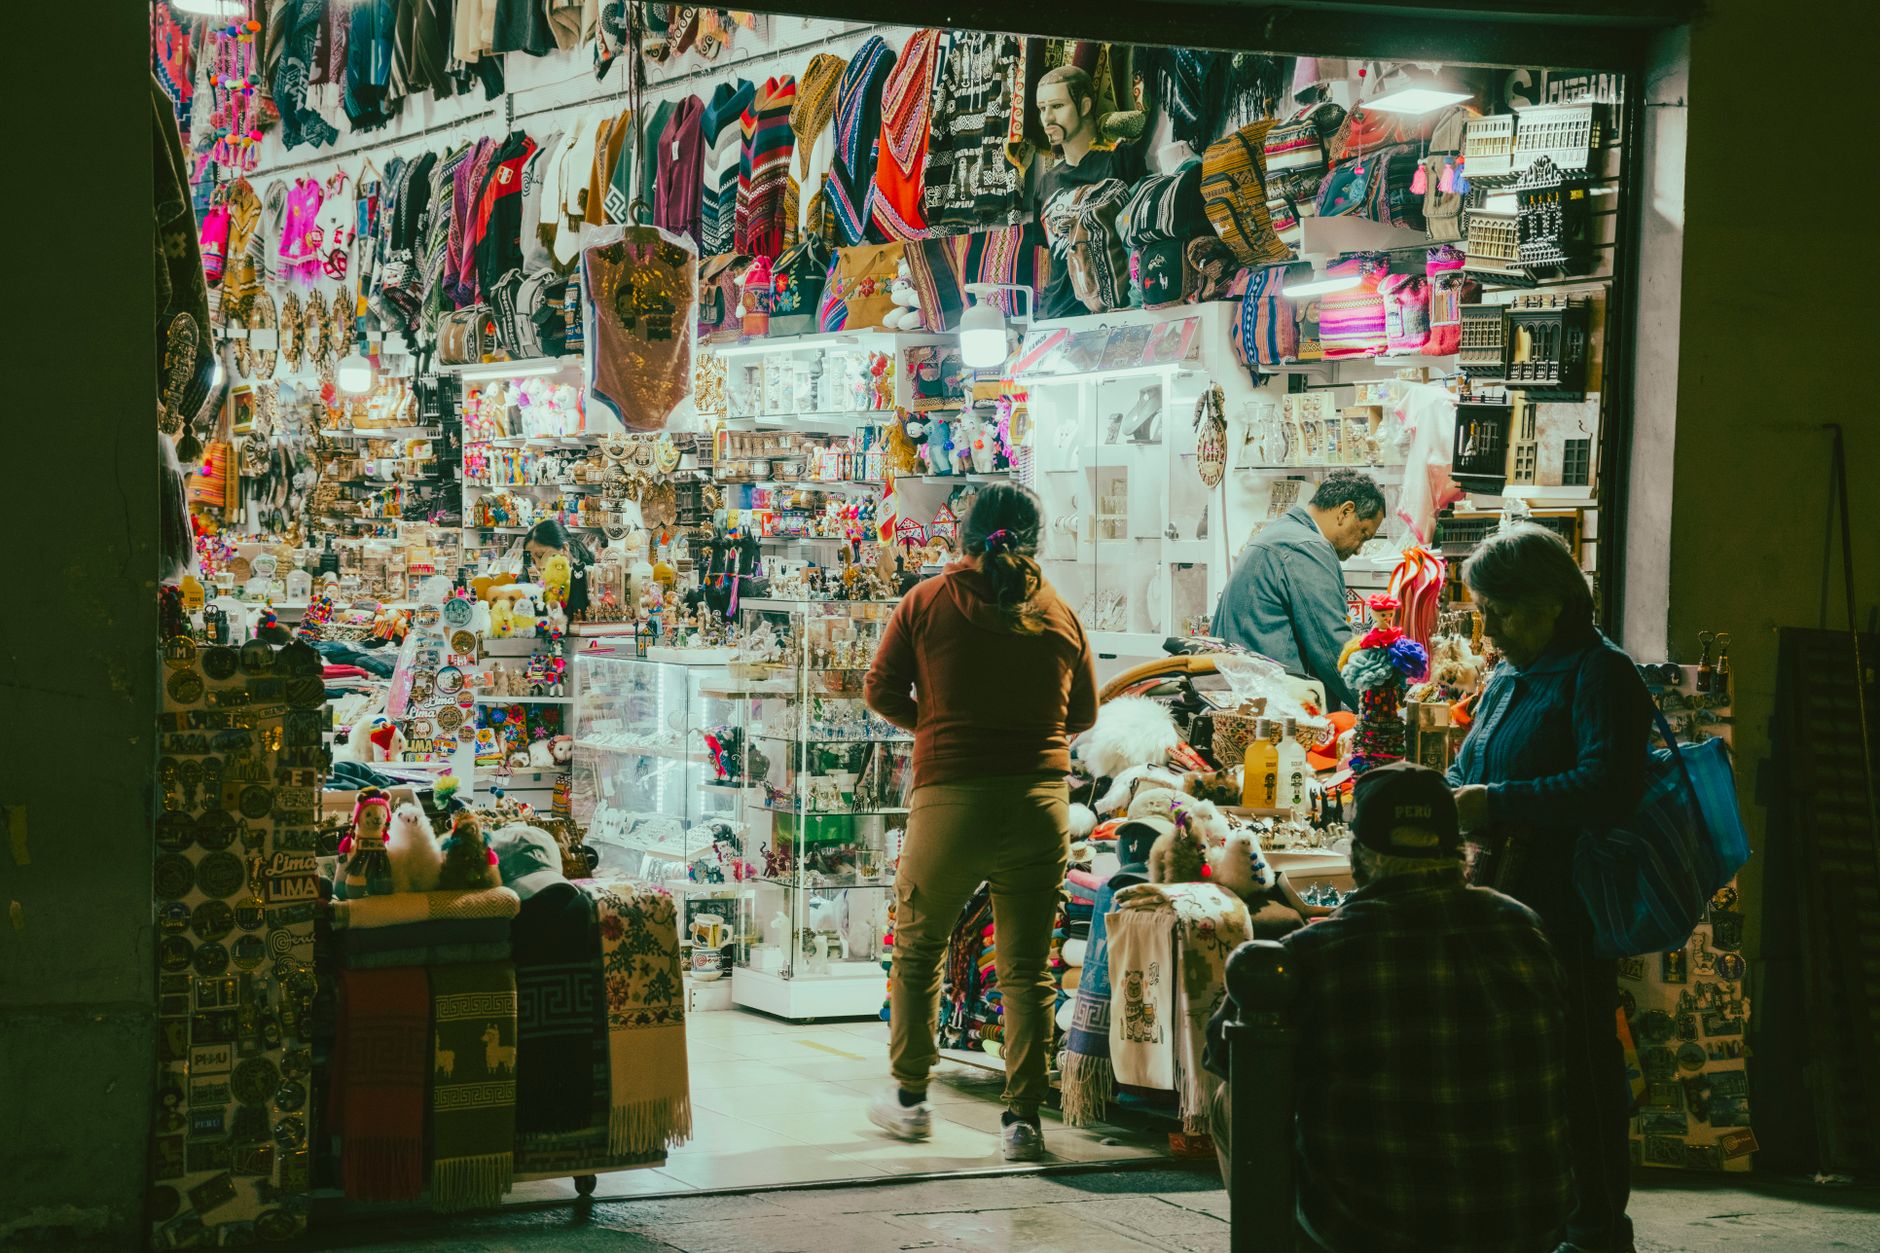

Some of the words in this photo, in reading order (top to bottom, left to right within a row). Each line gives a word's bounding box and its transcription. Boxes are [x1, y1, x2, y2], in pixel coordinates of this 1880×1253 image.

[1548, 73, 1617, 104] ENTRADA
[424, 694, 456, 708] Lima
[405, 706, 437, 720] Lima
[406, 739, 434, 753] LIMA
[265, 853, 318, 876] Lima
[269, 878, 320, 901] LIMA
